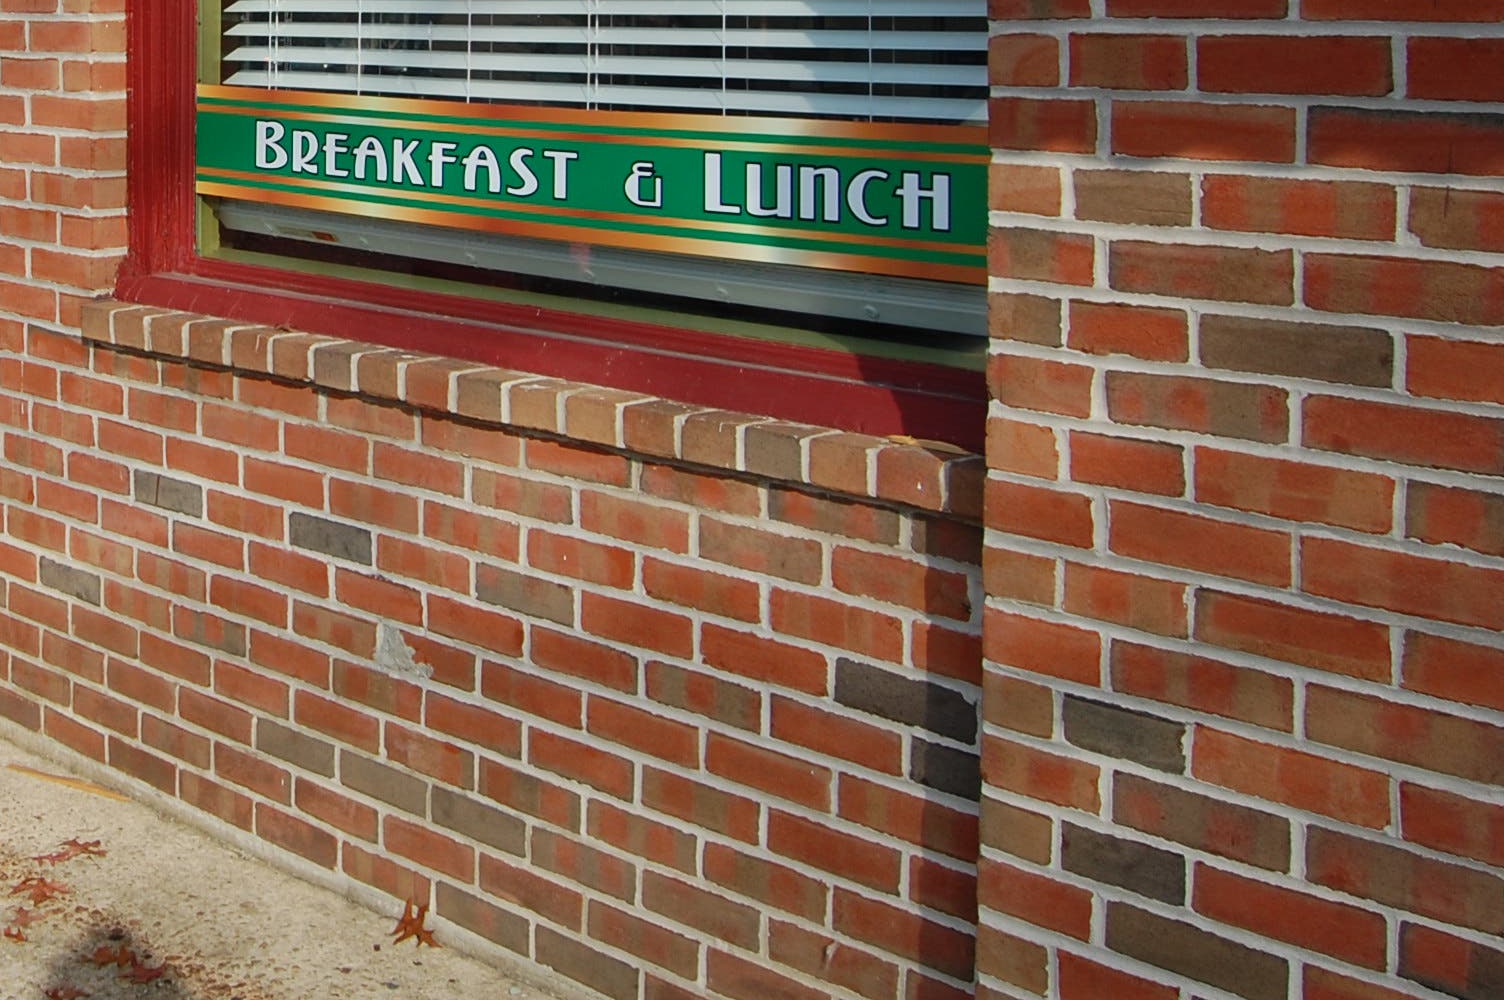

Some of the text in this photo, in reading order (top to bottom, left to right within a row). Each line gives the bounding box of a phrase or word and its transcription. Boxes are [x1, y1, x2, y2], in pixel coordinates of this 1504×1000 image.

[254, 119, 952, 232] BREAKFAST & LUNCH
